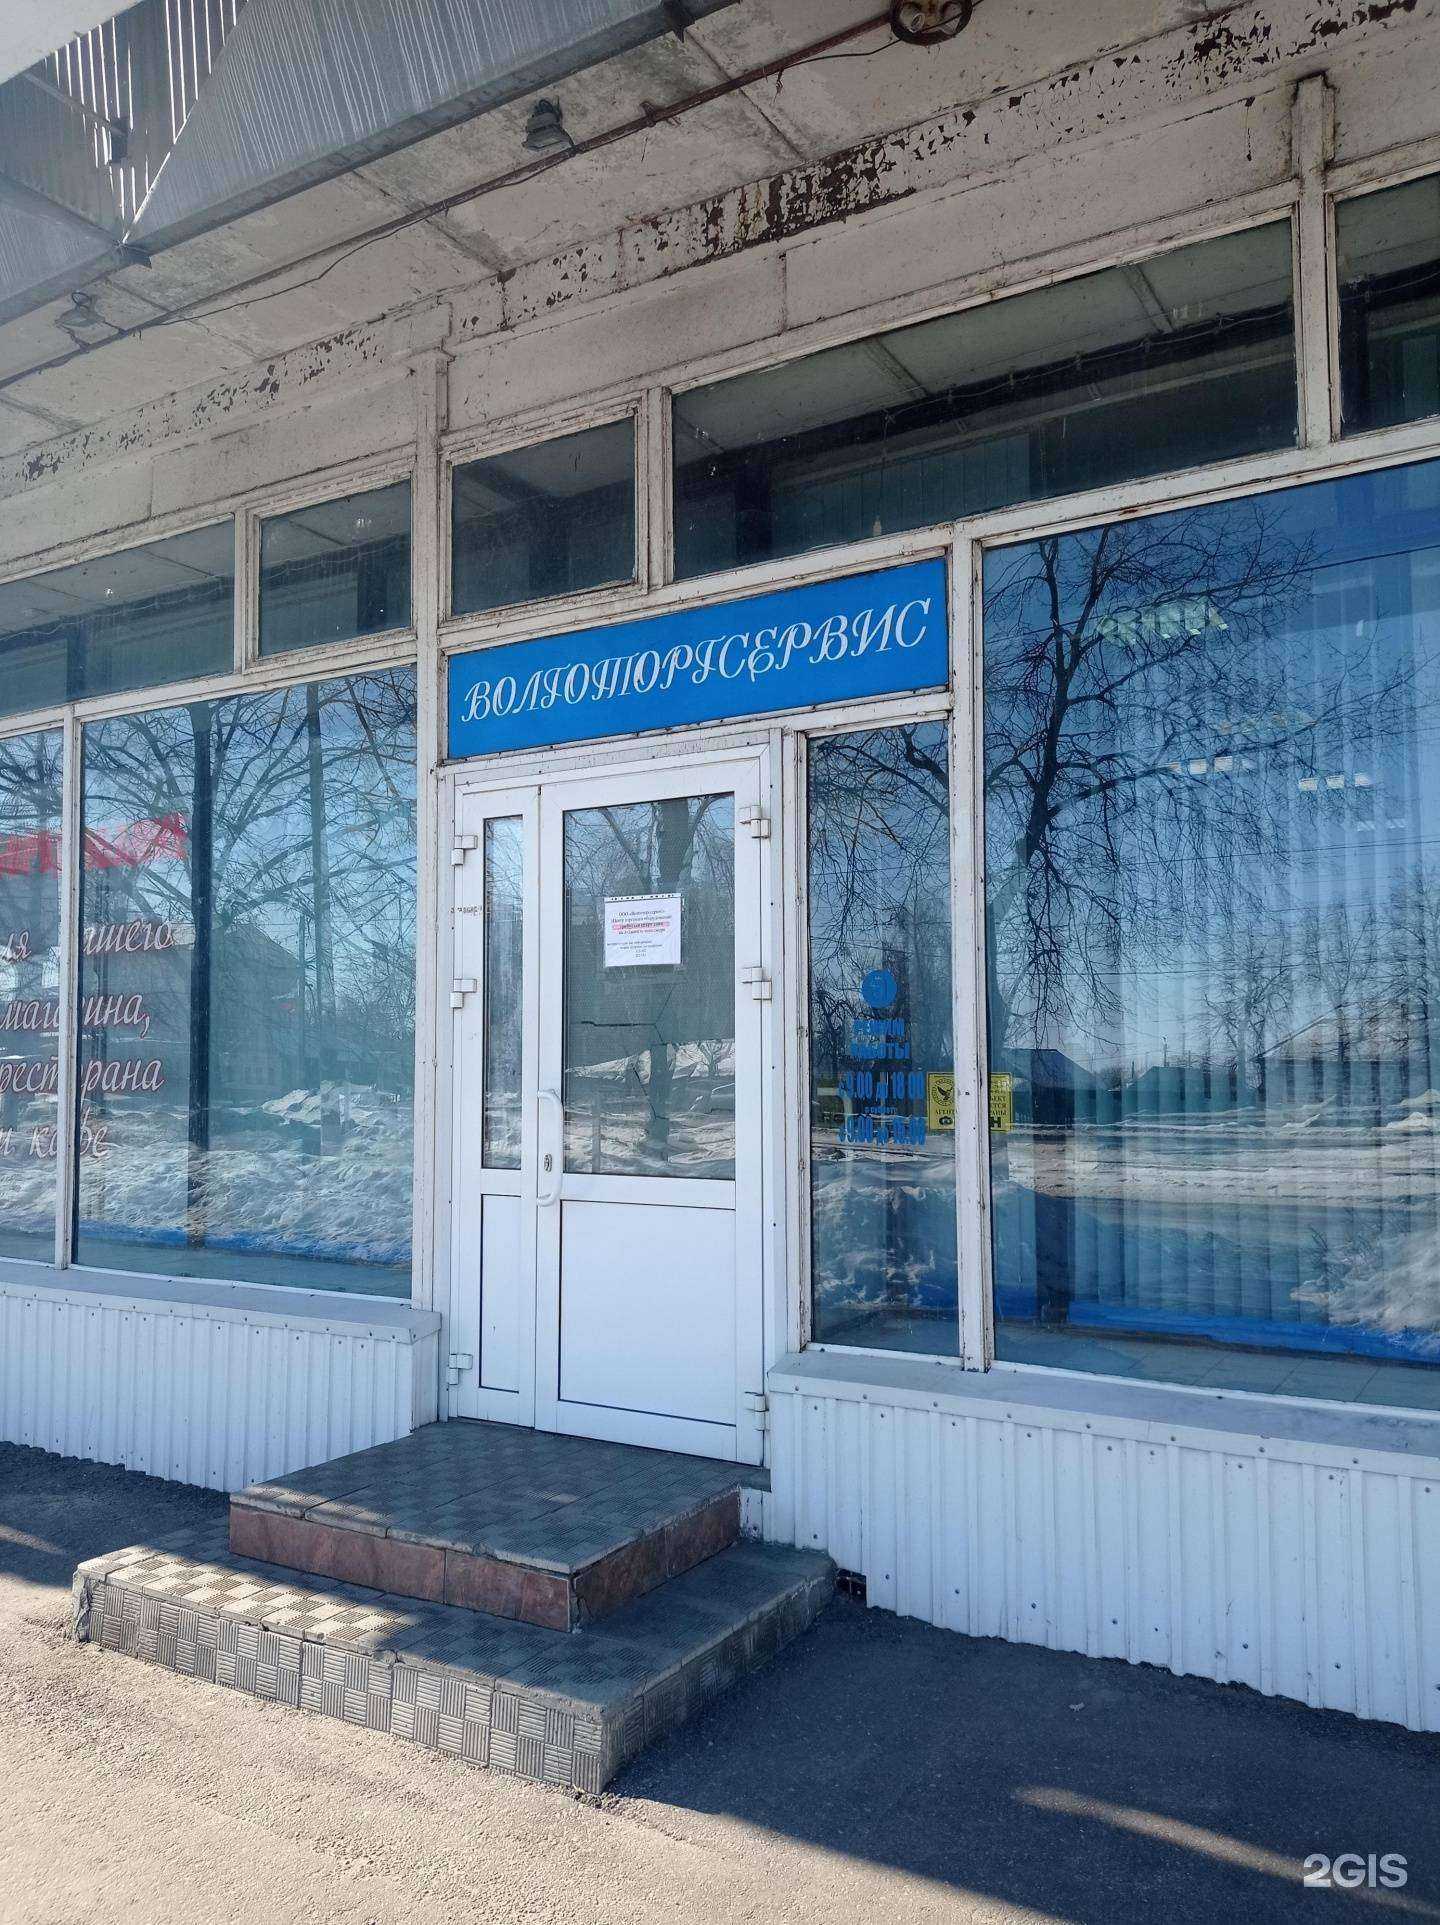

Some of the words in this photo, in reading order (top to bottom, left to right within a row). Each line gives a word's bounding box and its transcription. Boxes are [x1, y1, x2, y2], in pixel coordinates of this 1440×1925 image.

[461, 597, 932, 723] ВОЛГОТОРГСЕРВИС
[0, 930, 32, 962] ля
[83, 920, 174, 956] ашего
[0, 994, 150, 1039] магина,
[0, 1059, 165, 1105] рестрана
